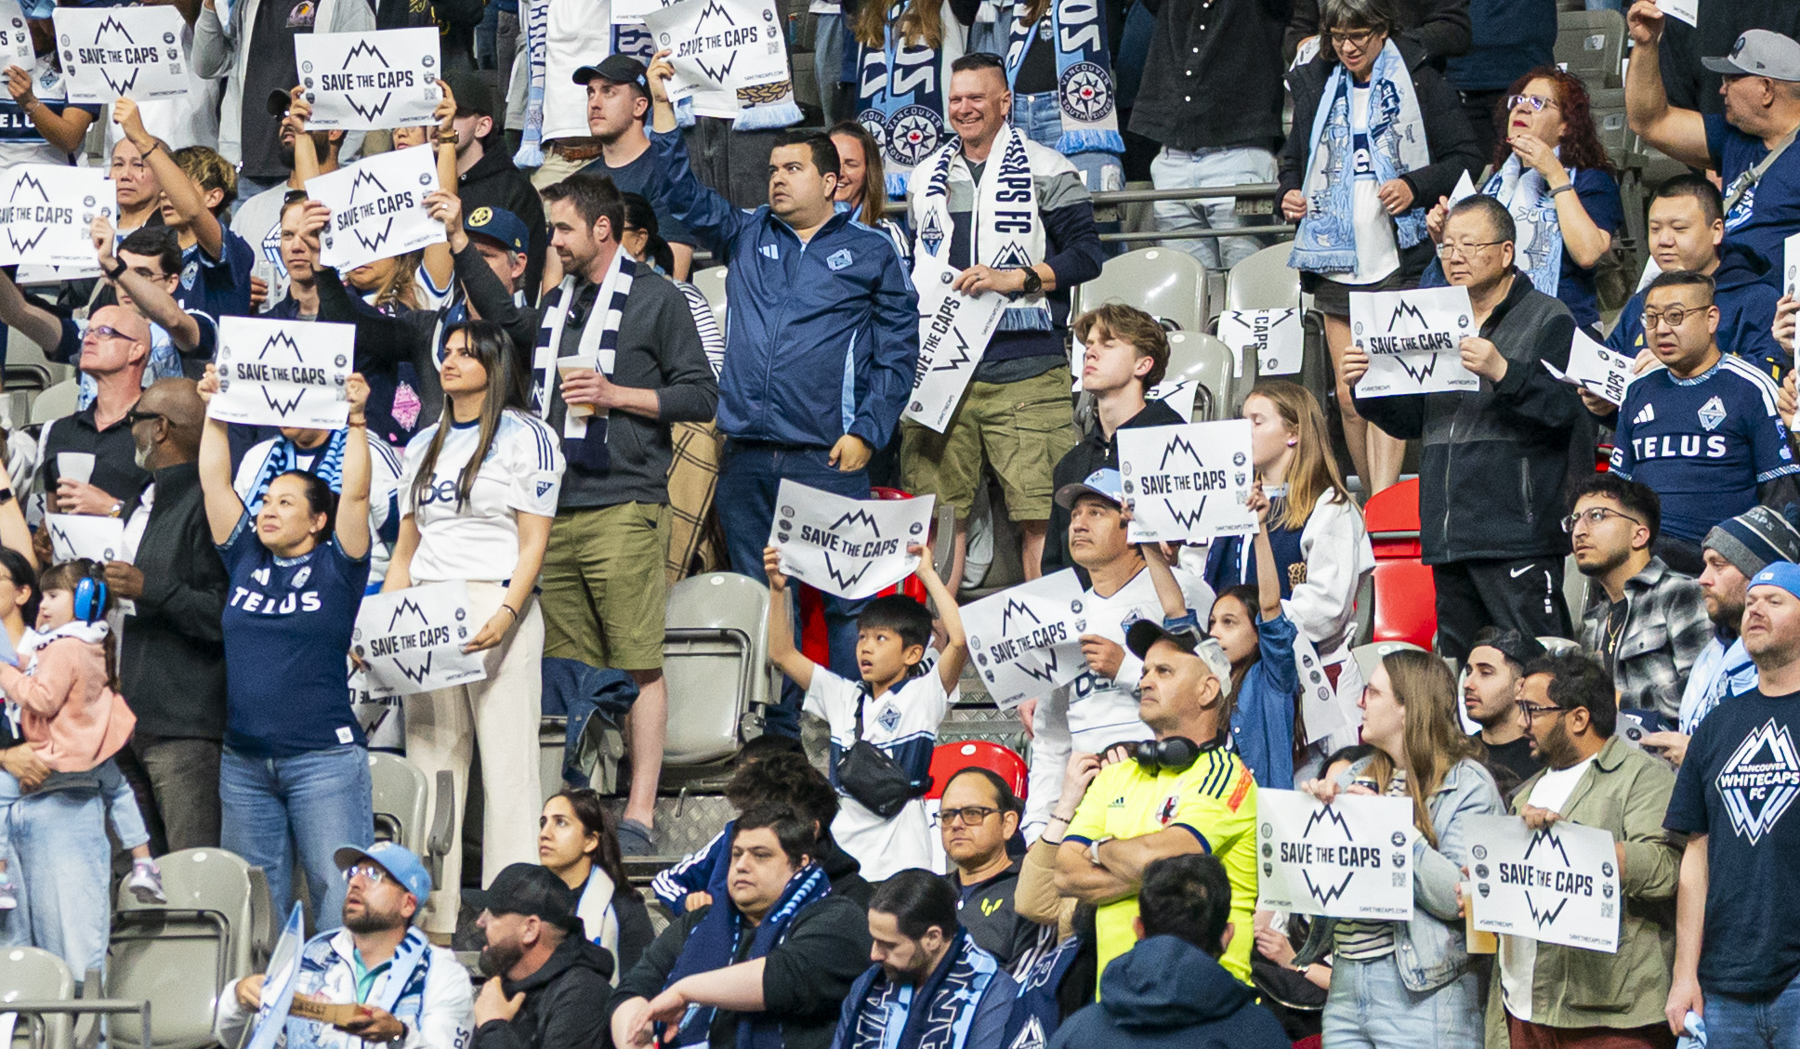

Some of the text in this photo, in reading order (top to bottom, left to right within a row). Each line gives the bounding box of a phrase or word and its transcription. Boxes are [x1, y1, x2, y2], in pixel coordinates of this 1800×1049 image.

[677, 26, 757, 57] SAVE THE CAPS
[321, 70, 413, 90] SAVE THE CAPS
[1061, 64, 1112, 91] VANCOUVER
[887, 106, 943, 130] VANCOUVER
[1061, 104, 1087, 121] SOUTH
[931, 296, 961, 335] CAPS
[922, 332, 942, 354] THE
[1369, 331, 1453, 354] SAVE THE CAPS
[237, 362, 326, 385] SAVE THE CAPS
[1631, 435, 1727, 460] TELUS
[230, 586, 322, 614] TELUS
[370, 625, 449, 657] SAVE THE CAPS
[1720, 771, 1800, 788] WHITECAPS
[1737, 762, 1787, 773] VANCOUVER
[1749, 787, 1766, 800] FC
[1280, 842, 1380, 868] SAVE THE CAPS
[1499, 862, 1592, 896] SAVE THE CAPS
